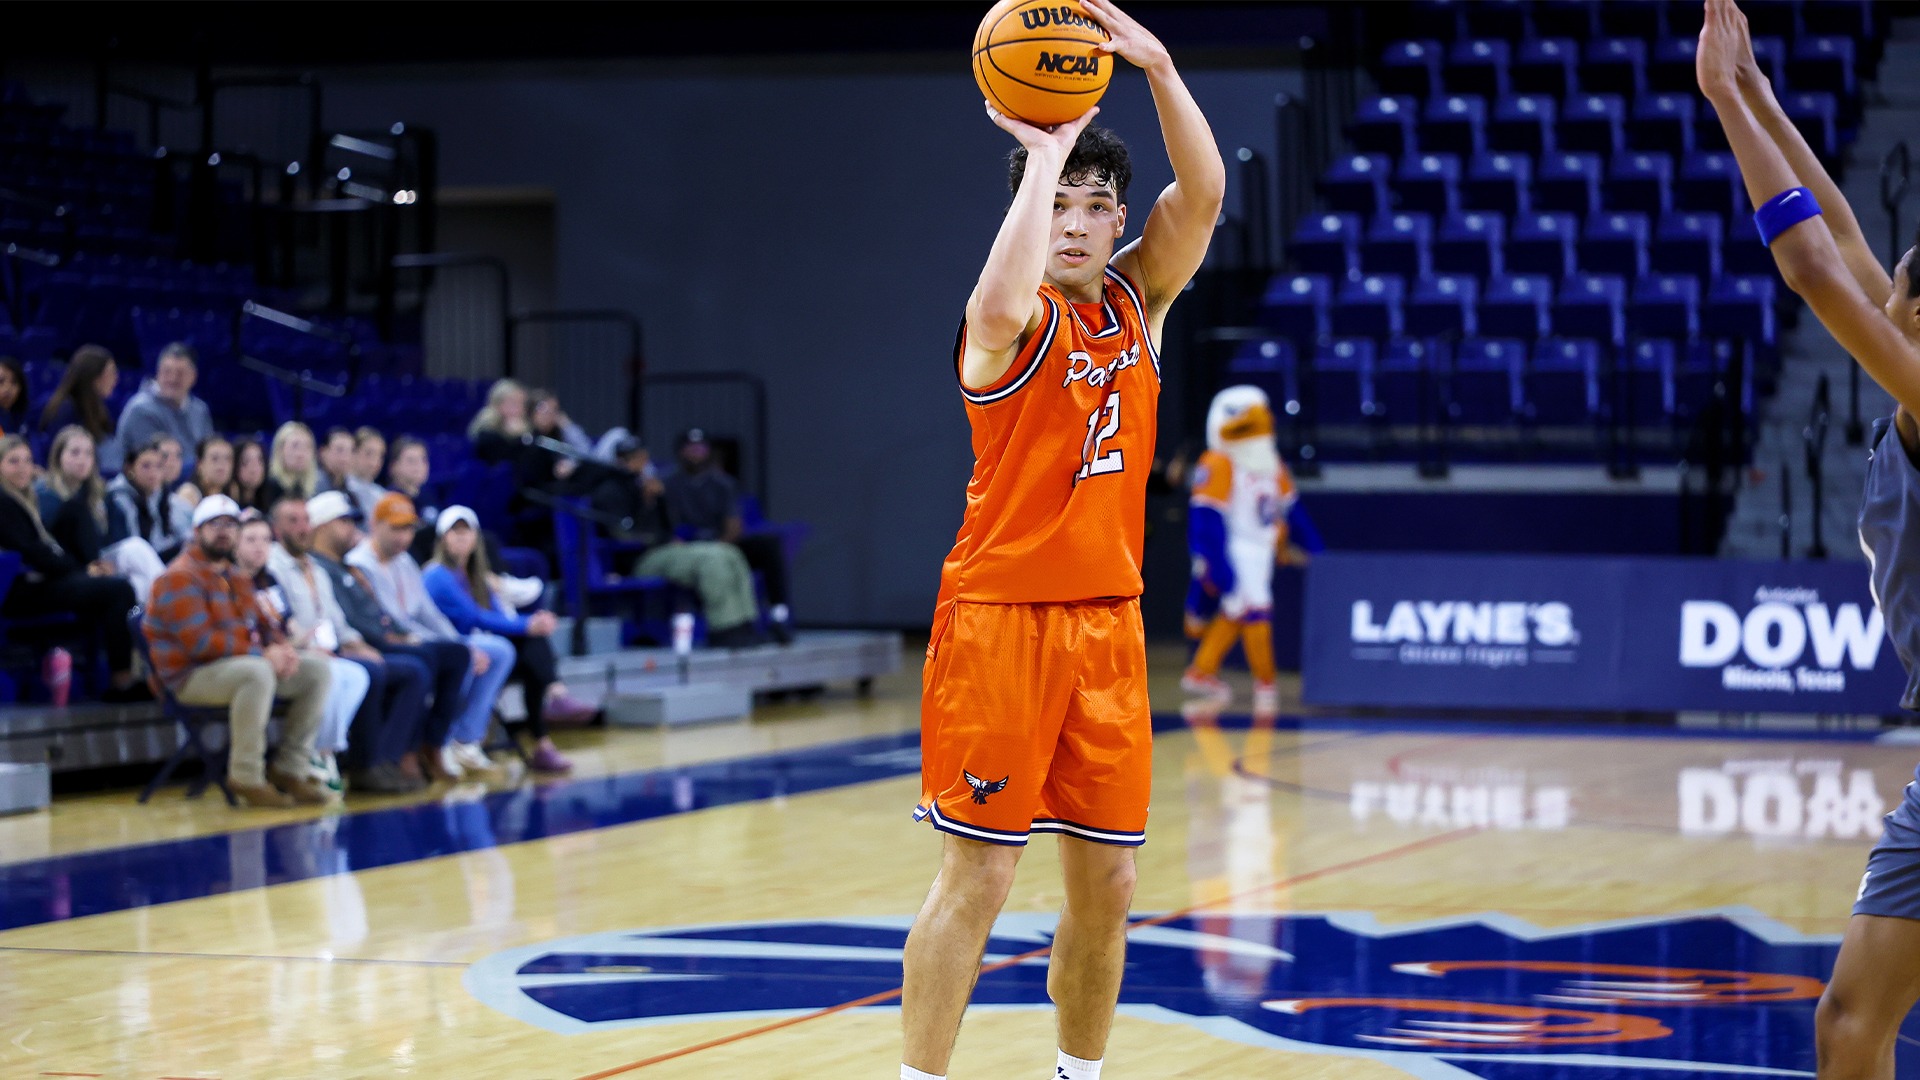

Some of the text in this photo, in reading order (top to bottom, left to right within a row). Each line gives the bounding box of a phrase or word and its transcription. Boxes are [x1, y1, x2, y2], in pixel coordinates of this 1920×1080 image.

[1035, 51, 1098, 76] NCAA
[1072, 390, 1124, 488] 12
[1351, 600, 1572, 646] LAYNE'S
[1680, 600, 1884, 670] DOW
